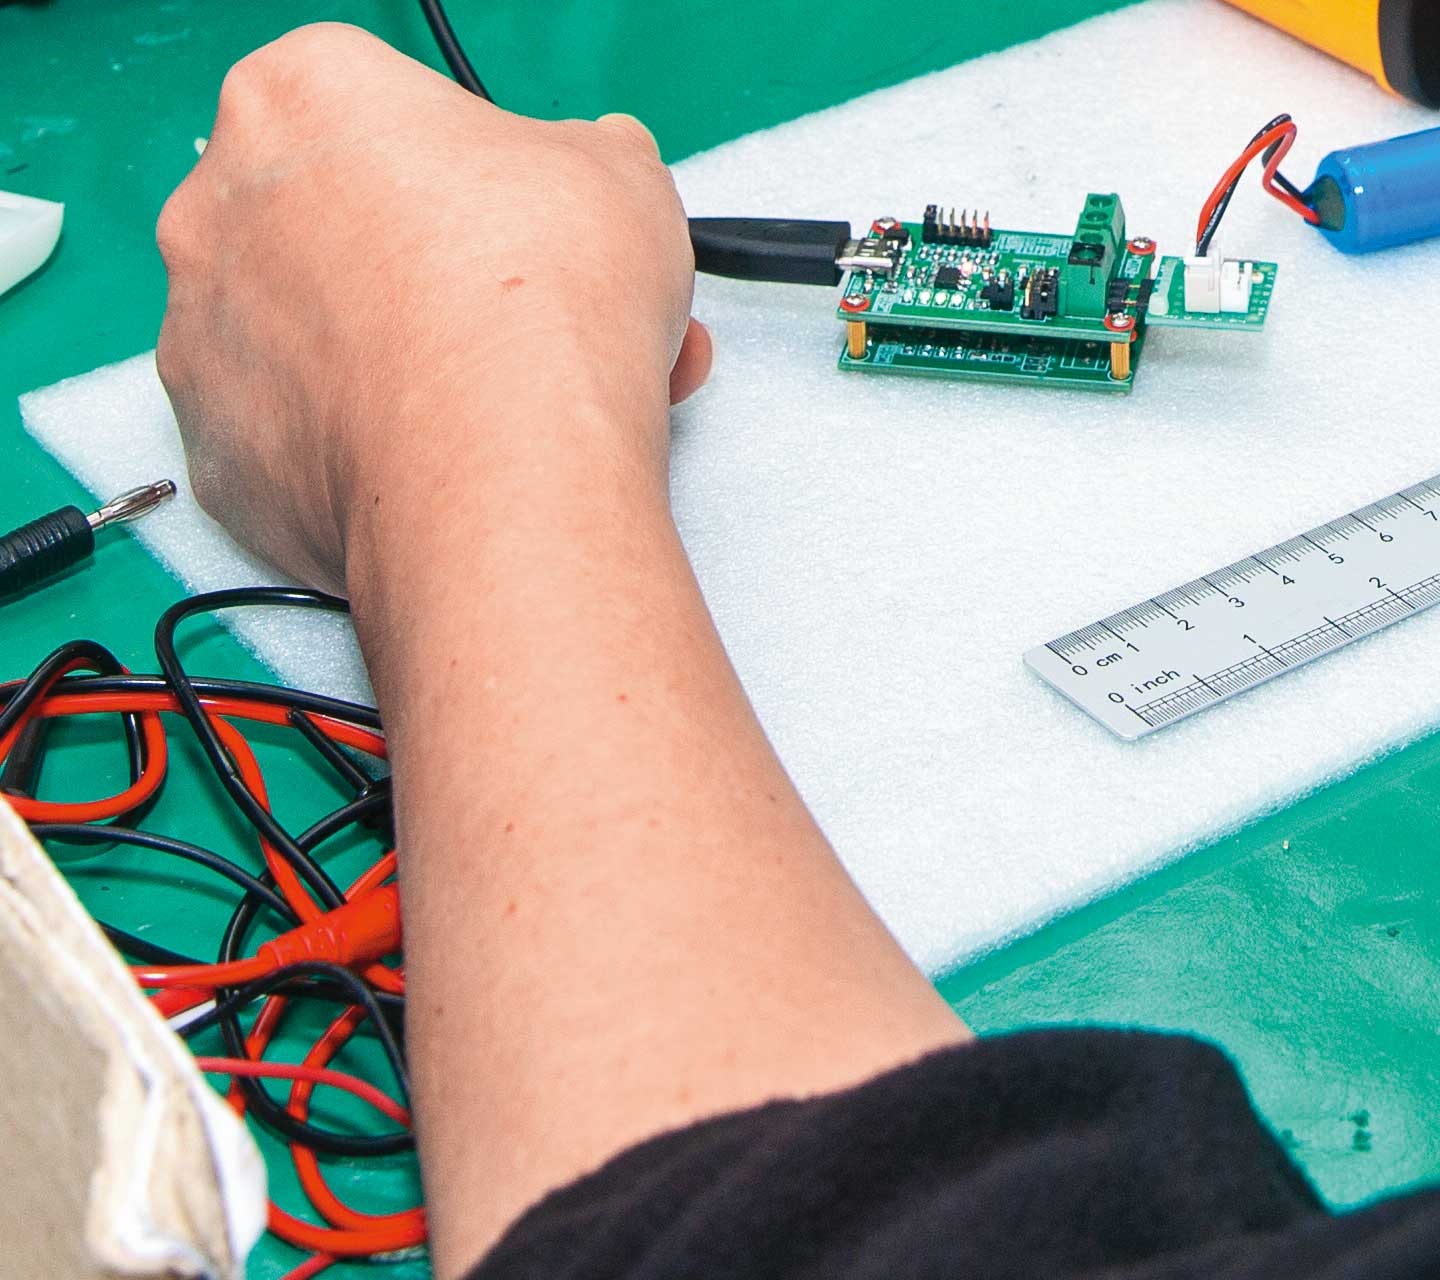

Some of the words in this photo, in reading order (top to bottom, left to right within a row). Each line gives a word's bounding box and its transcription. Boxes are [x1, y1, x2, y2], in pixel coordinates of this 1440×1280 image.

[1071, 663, 1089, 678] 0
[1095, 650, 1123, 669] cm
[1125, 640, 1141, 654] 1
[1176, 618, 1196, 633] 2
[1228, 596, 1246, 610] 3
[1280, 574, 1296, 588] 4
[1327, 552, 1345, 567] 5
[1379, 531, 1395, 544] 6
[1422, 509, 1439, 522] 7
[1107, 690, 1126, 705] 0
[1133, 667, 1182, 695] inch
[1242, 632, 1258, 646] 1
[1368, 575, 1388, 590] 2
